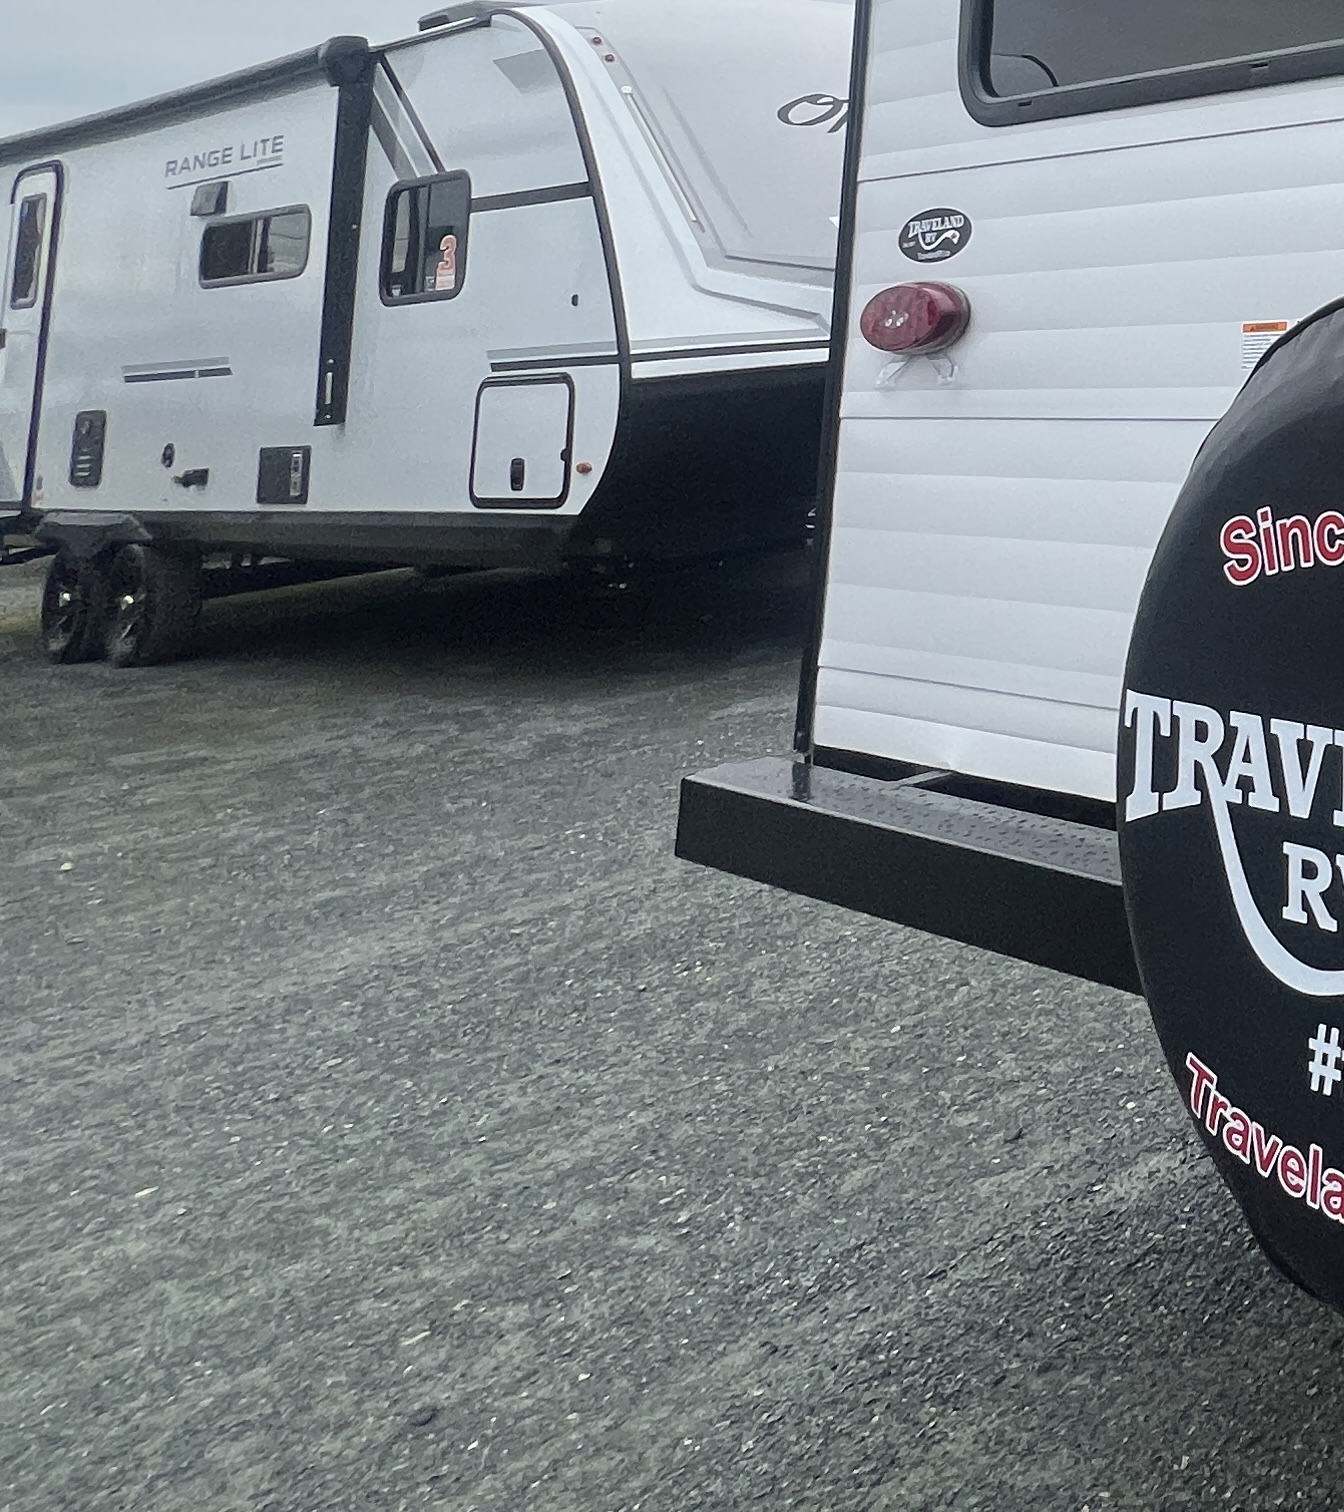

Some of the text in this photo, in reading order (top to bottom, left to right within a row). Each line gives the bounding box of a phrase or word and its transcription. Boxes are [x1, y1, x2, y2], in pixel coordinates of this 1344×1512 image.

[165, 135, 284, 177] RANGE LITE
[908, 215, 964, 238] TRAVELAND
